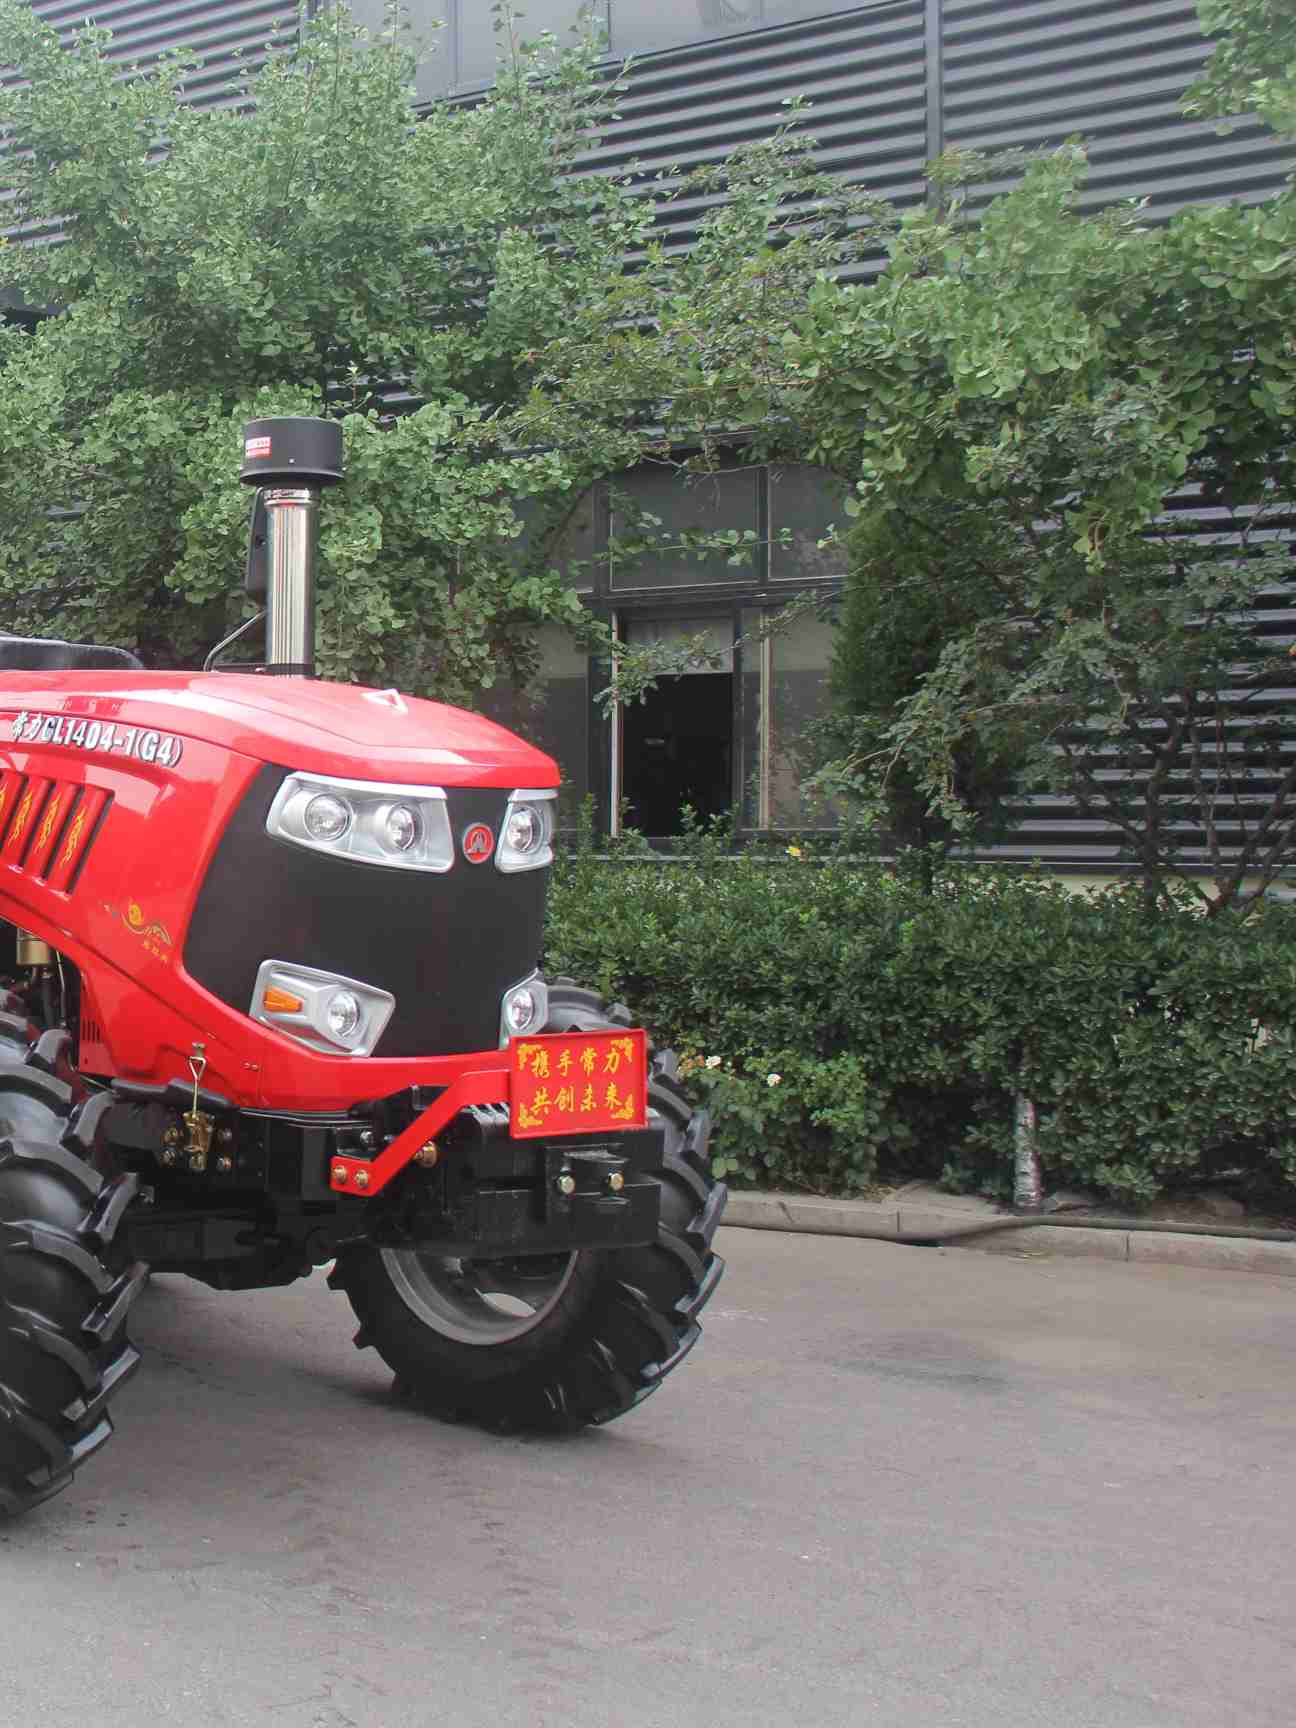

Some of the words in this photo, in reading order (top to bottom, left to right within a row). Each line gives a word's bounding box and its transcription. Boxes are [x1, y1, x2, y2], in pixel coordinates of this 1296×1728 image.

[531, 1047, 620, 1078] 携手常力
[530, 1082, 623, 1114] 共创未来
